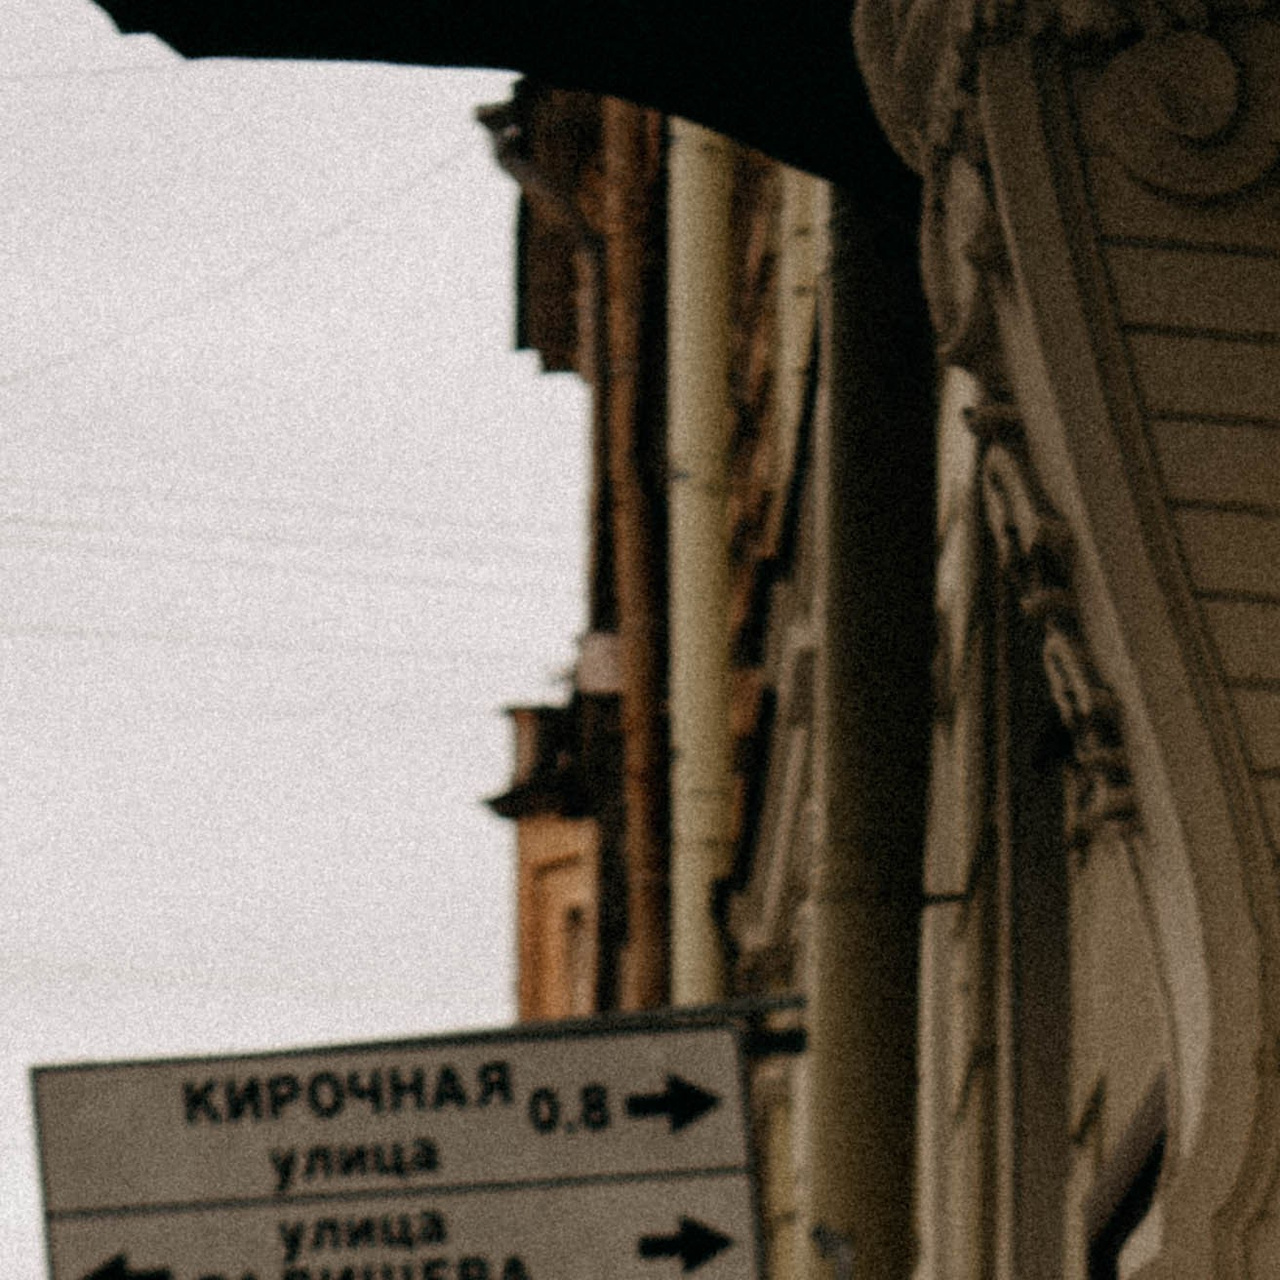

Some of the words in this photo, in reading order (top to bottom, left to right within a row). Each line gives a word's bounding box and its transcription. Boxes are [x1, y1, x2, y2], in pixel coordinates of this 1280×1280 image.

[182, 1060, 514, 1126] КИРОЧНАЯ
[528, 1083, 611, 1134] 0.8
[270, 1137, 441, 1192] улица
[279, 1210, 449, 1260] улица
